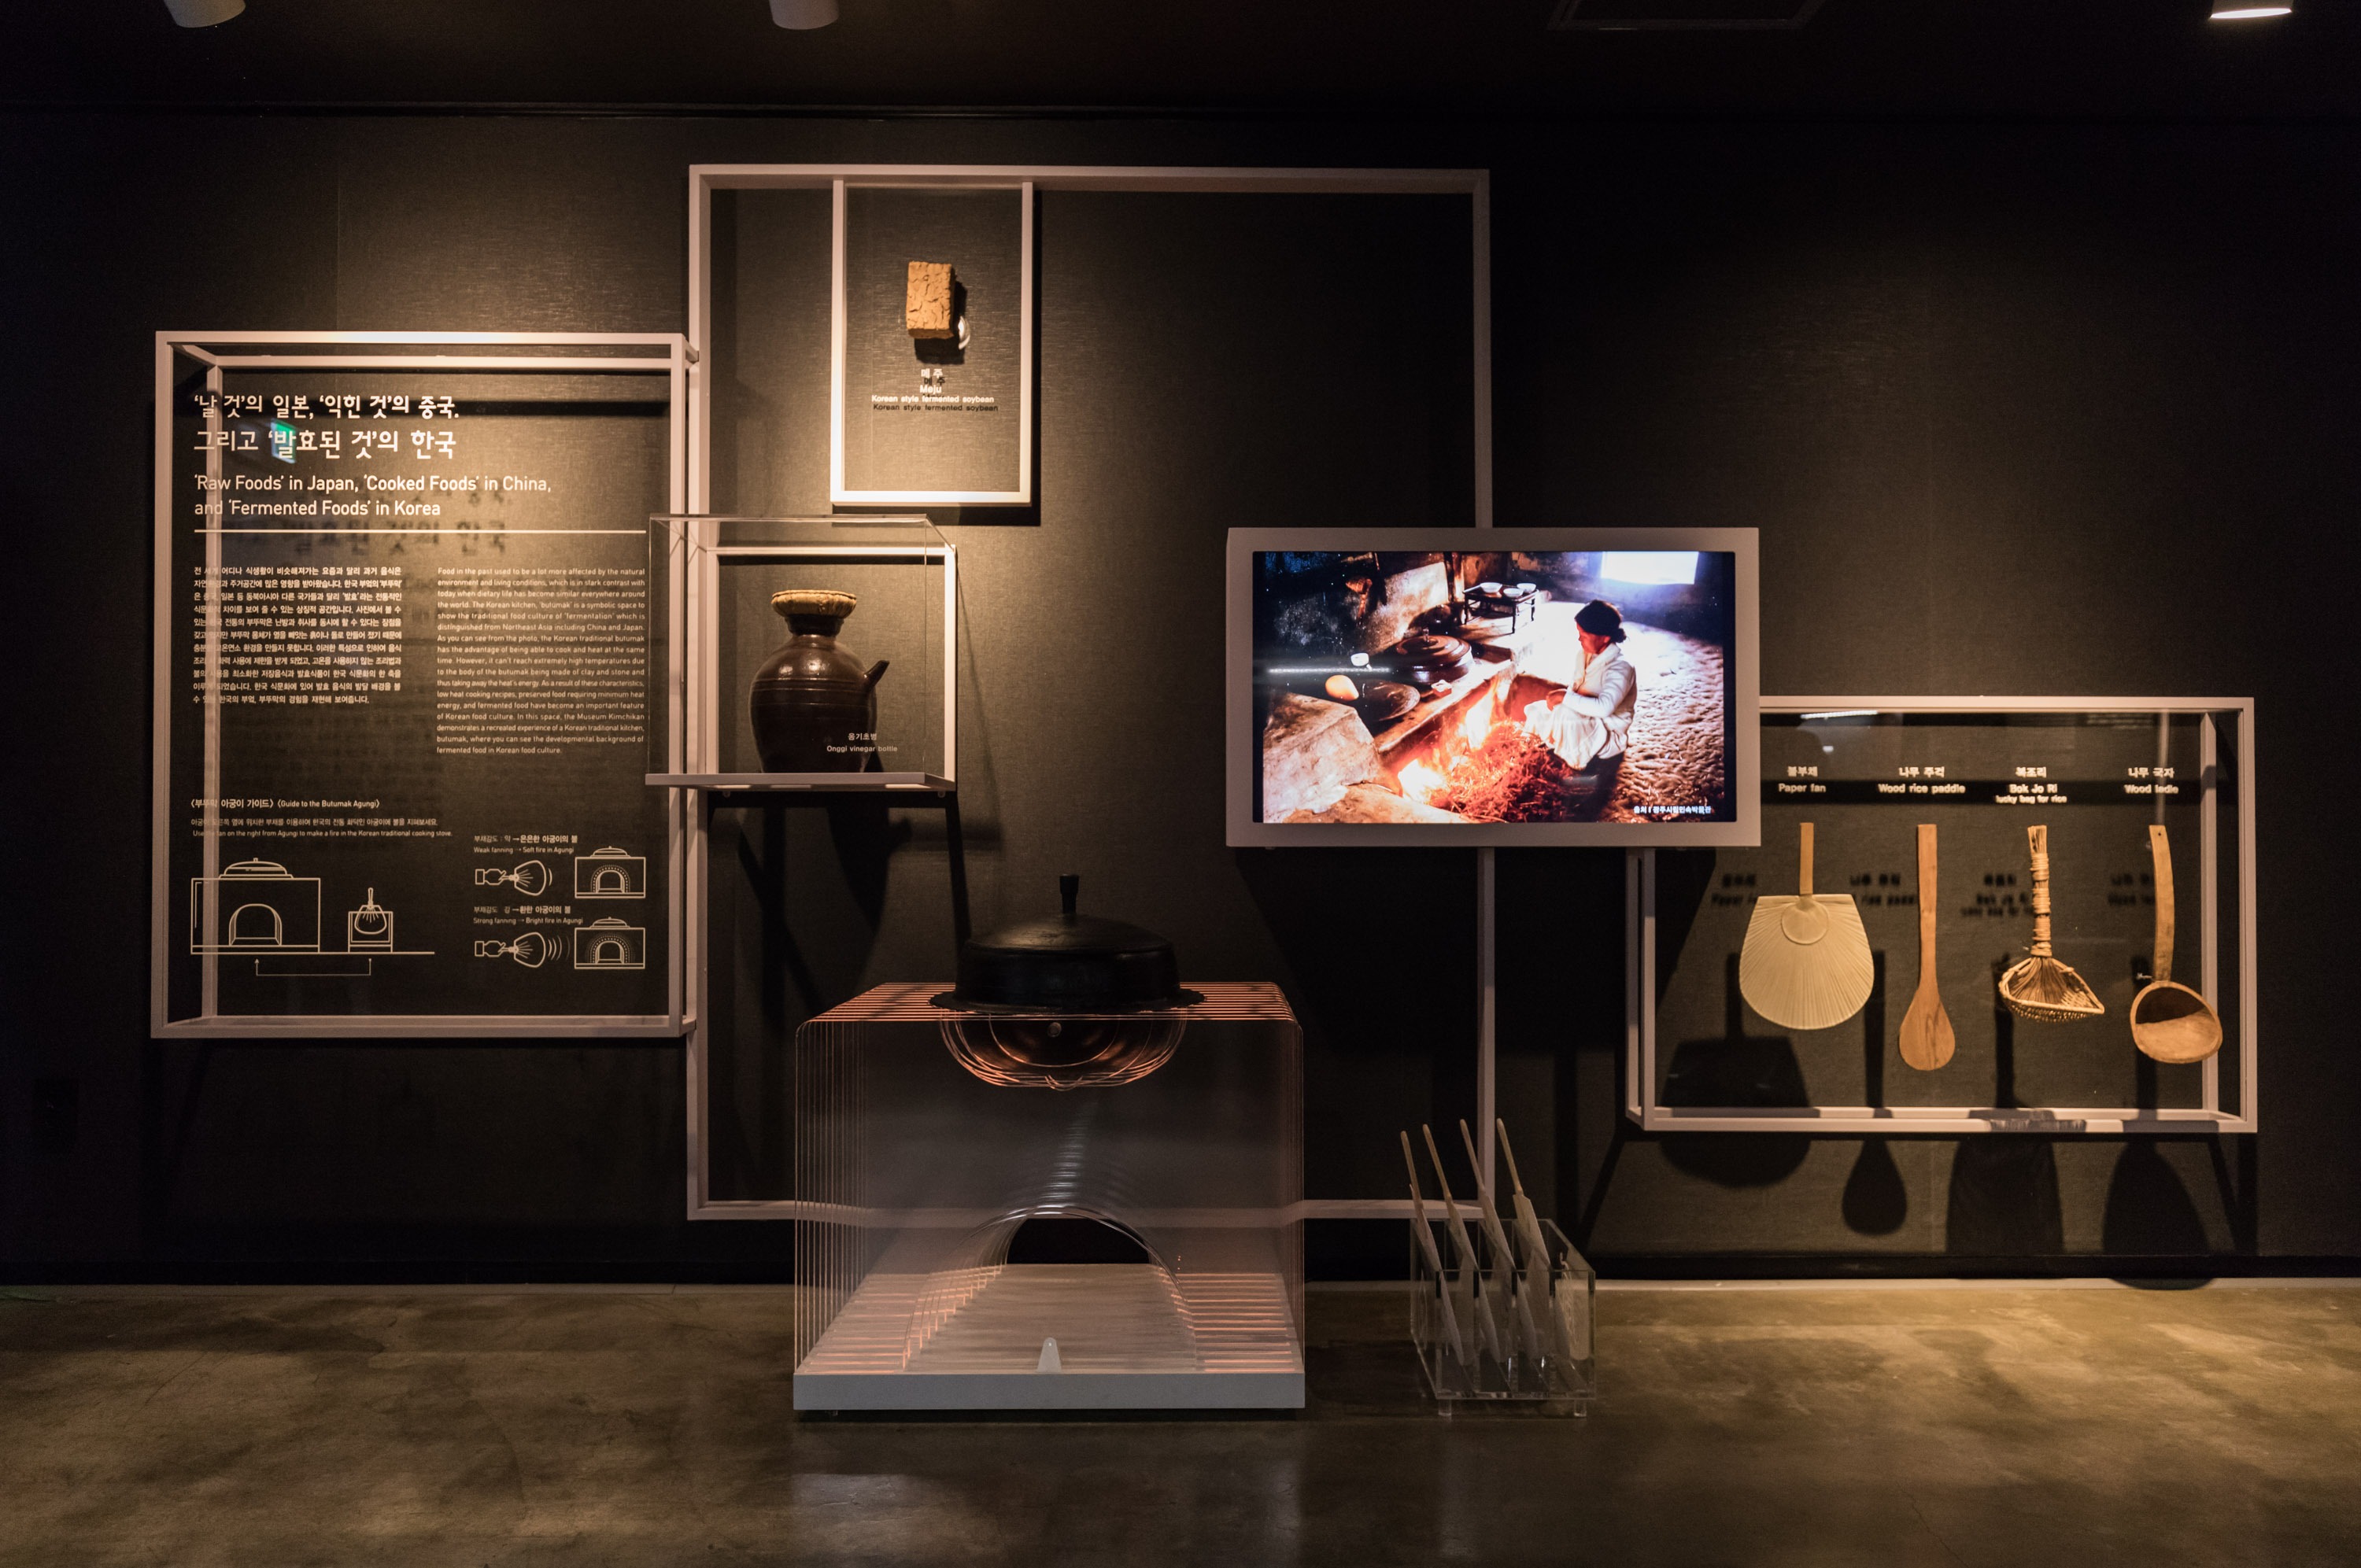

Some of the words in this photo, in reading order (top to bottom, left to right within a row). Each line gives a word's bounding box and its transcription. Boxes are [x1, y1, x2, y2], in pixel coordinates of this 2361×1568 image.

[919, 384, 942, 395] Meju
[901, 394, 918, 403] style
[922, 394, 959, 403] fermented
[963, 394, 994, 403] soybean
[272, 394, 314, 420] 일본,
[193, 430, 259, 452] 그리고
[410, 430, 456, 459] 한국
[289, 475, 303, 491] in
[307, 474, 359, 495] Japan,
[484, 474, 498, 491] in
[502, 474, 552, 494] China,
[195, 500, 222, 518] and
[376, 500, 389, 515] in
[394, 499, 441, 516] Korea
[438, 577, 478, 587] environment
[1779, 783, 1807, 793] Paper
[1810, 784, 1826, 792] fan
[1878, 784, 1905, 793] Wood
[1909, 783, 1928, 793] rice
[1931, 784, 1965, 795] paddle
[2009, 784, 2029, 795] Bok
[2031, 784, 2044, 795] Jo
[2047, 784, 2057, 795] Ri
[2124, 784, 2152, 793] Wood
[2155, 783, 2178, 794] ladle
[278, 799, 300, 808] 〈Guide
[353, 799, 379, 809] Agungi〉
[1996, 795, 2017, 804] lucky
[2019, 795, 2035, 804] bag
[2037, 795, 2049, 803] for
